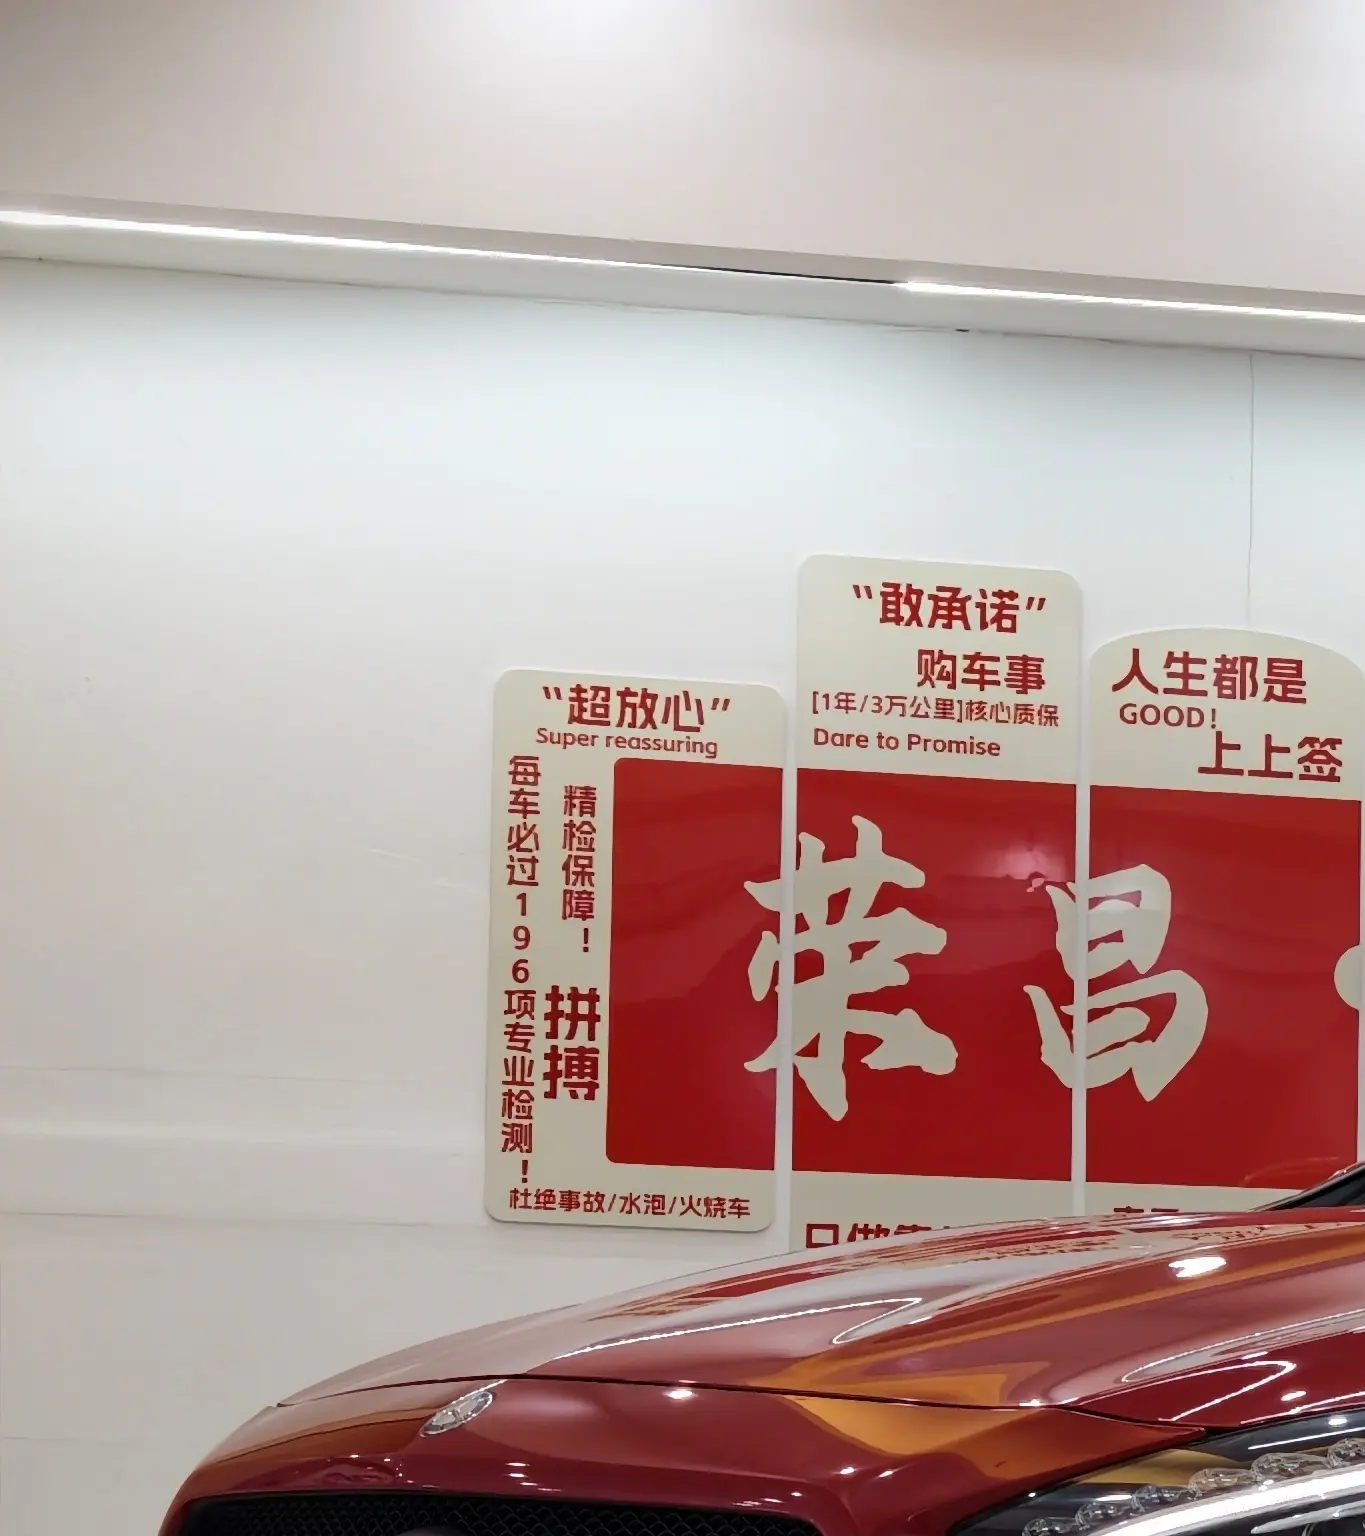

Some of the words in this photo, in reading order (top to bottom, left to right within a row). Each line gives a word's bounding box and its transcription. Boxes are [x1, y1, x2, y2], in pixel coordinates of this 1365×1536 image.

[851, 581, 1047, 635] “敢承诺”
[916, 648, 1046, 696] 购车事
[1110, 647, 1307, 705] 人生都是
[541, 682, 732, 733] “超放心”
[1118, 702, 1218, 730] GOOD!
[535, 726, 601, 750] Super
[604, 730, 719, 759] reassuring
[813, 727, 869, 748] Dare
[875, 732, 901, 752] to
[906, 734, 1001, 757] Promise
[1197, 730, 1344, 784] 上上签
[542, 983, 602, 1103] 拼搏
[507, 1186, 753, 1220] 杜绝事故/水泡/火烧车
